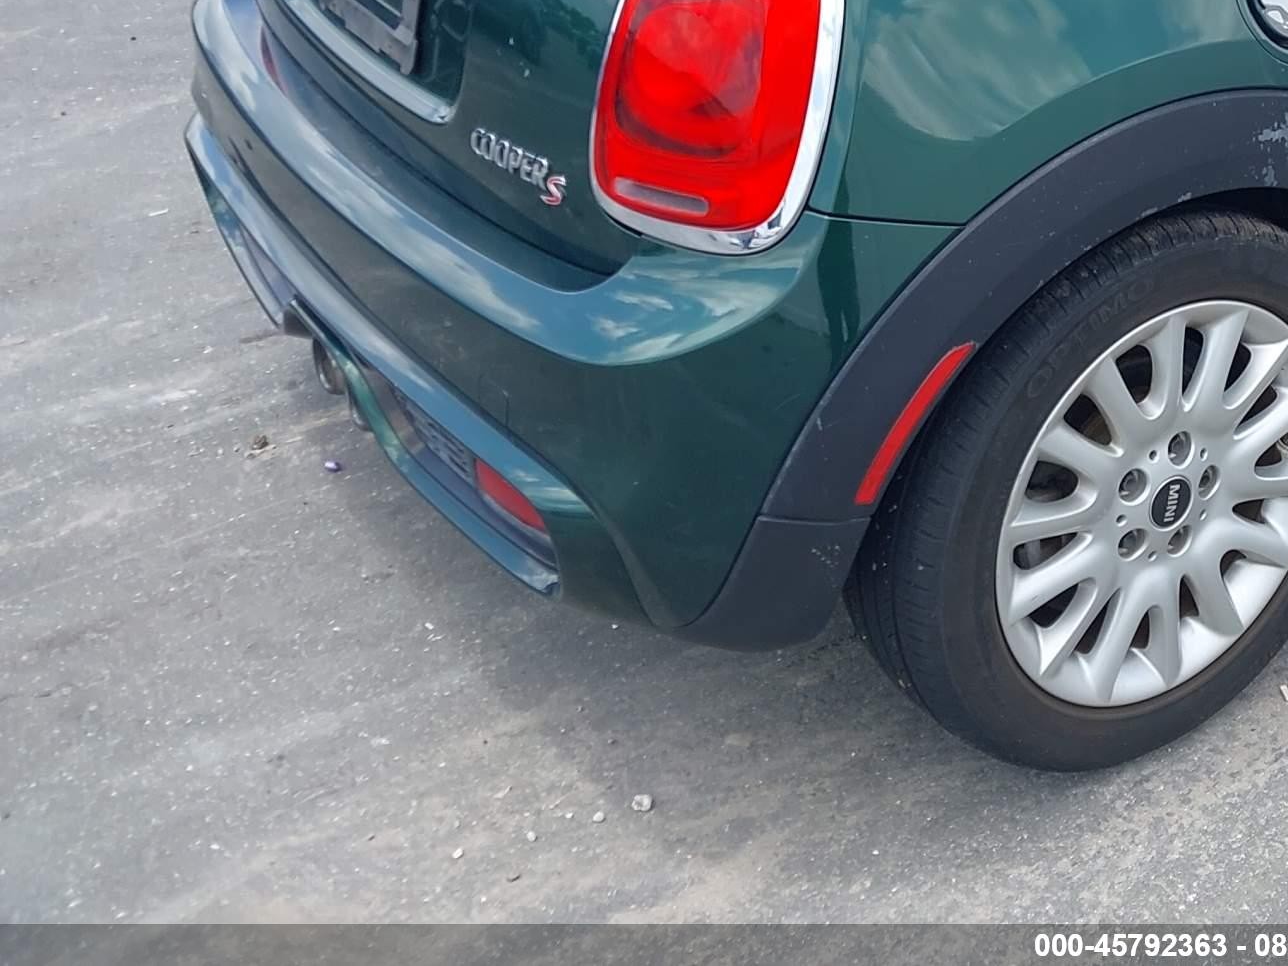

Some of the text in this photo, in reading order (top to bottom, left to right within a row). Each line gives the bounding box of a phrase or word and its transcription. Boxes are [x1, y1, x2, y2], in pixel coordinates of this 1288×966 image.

[471, 128, 567, 206] COOPER S
[1163, 484, 1181, 523] MINI
